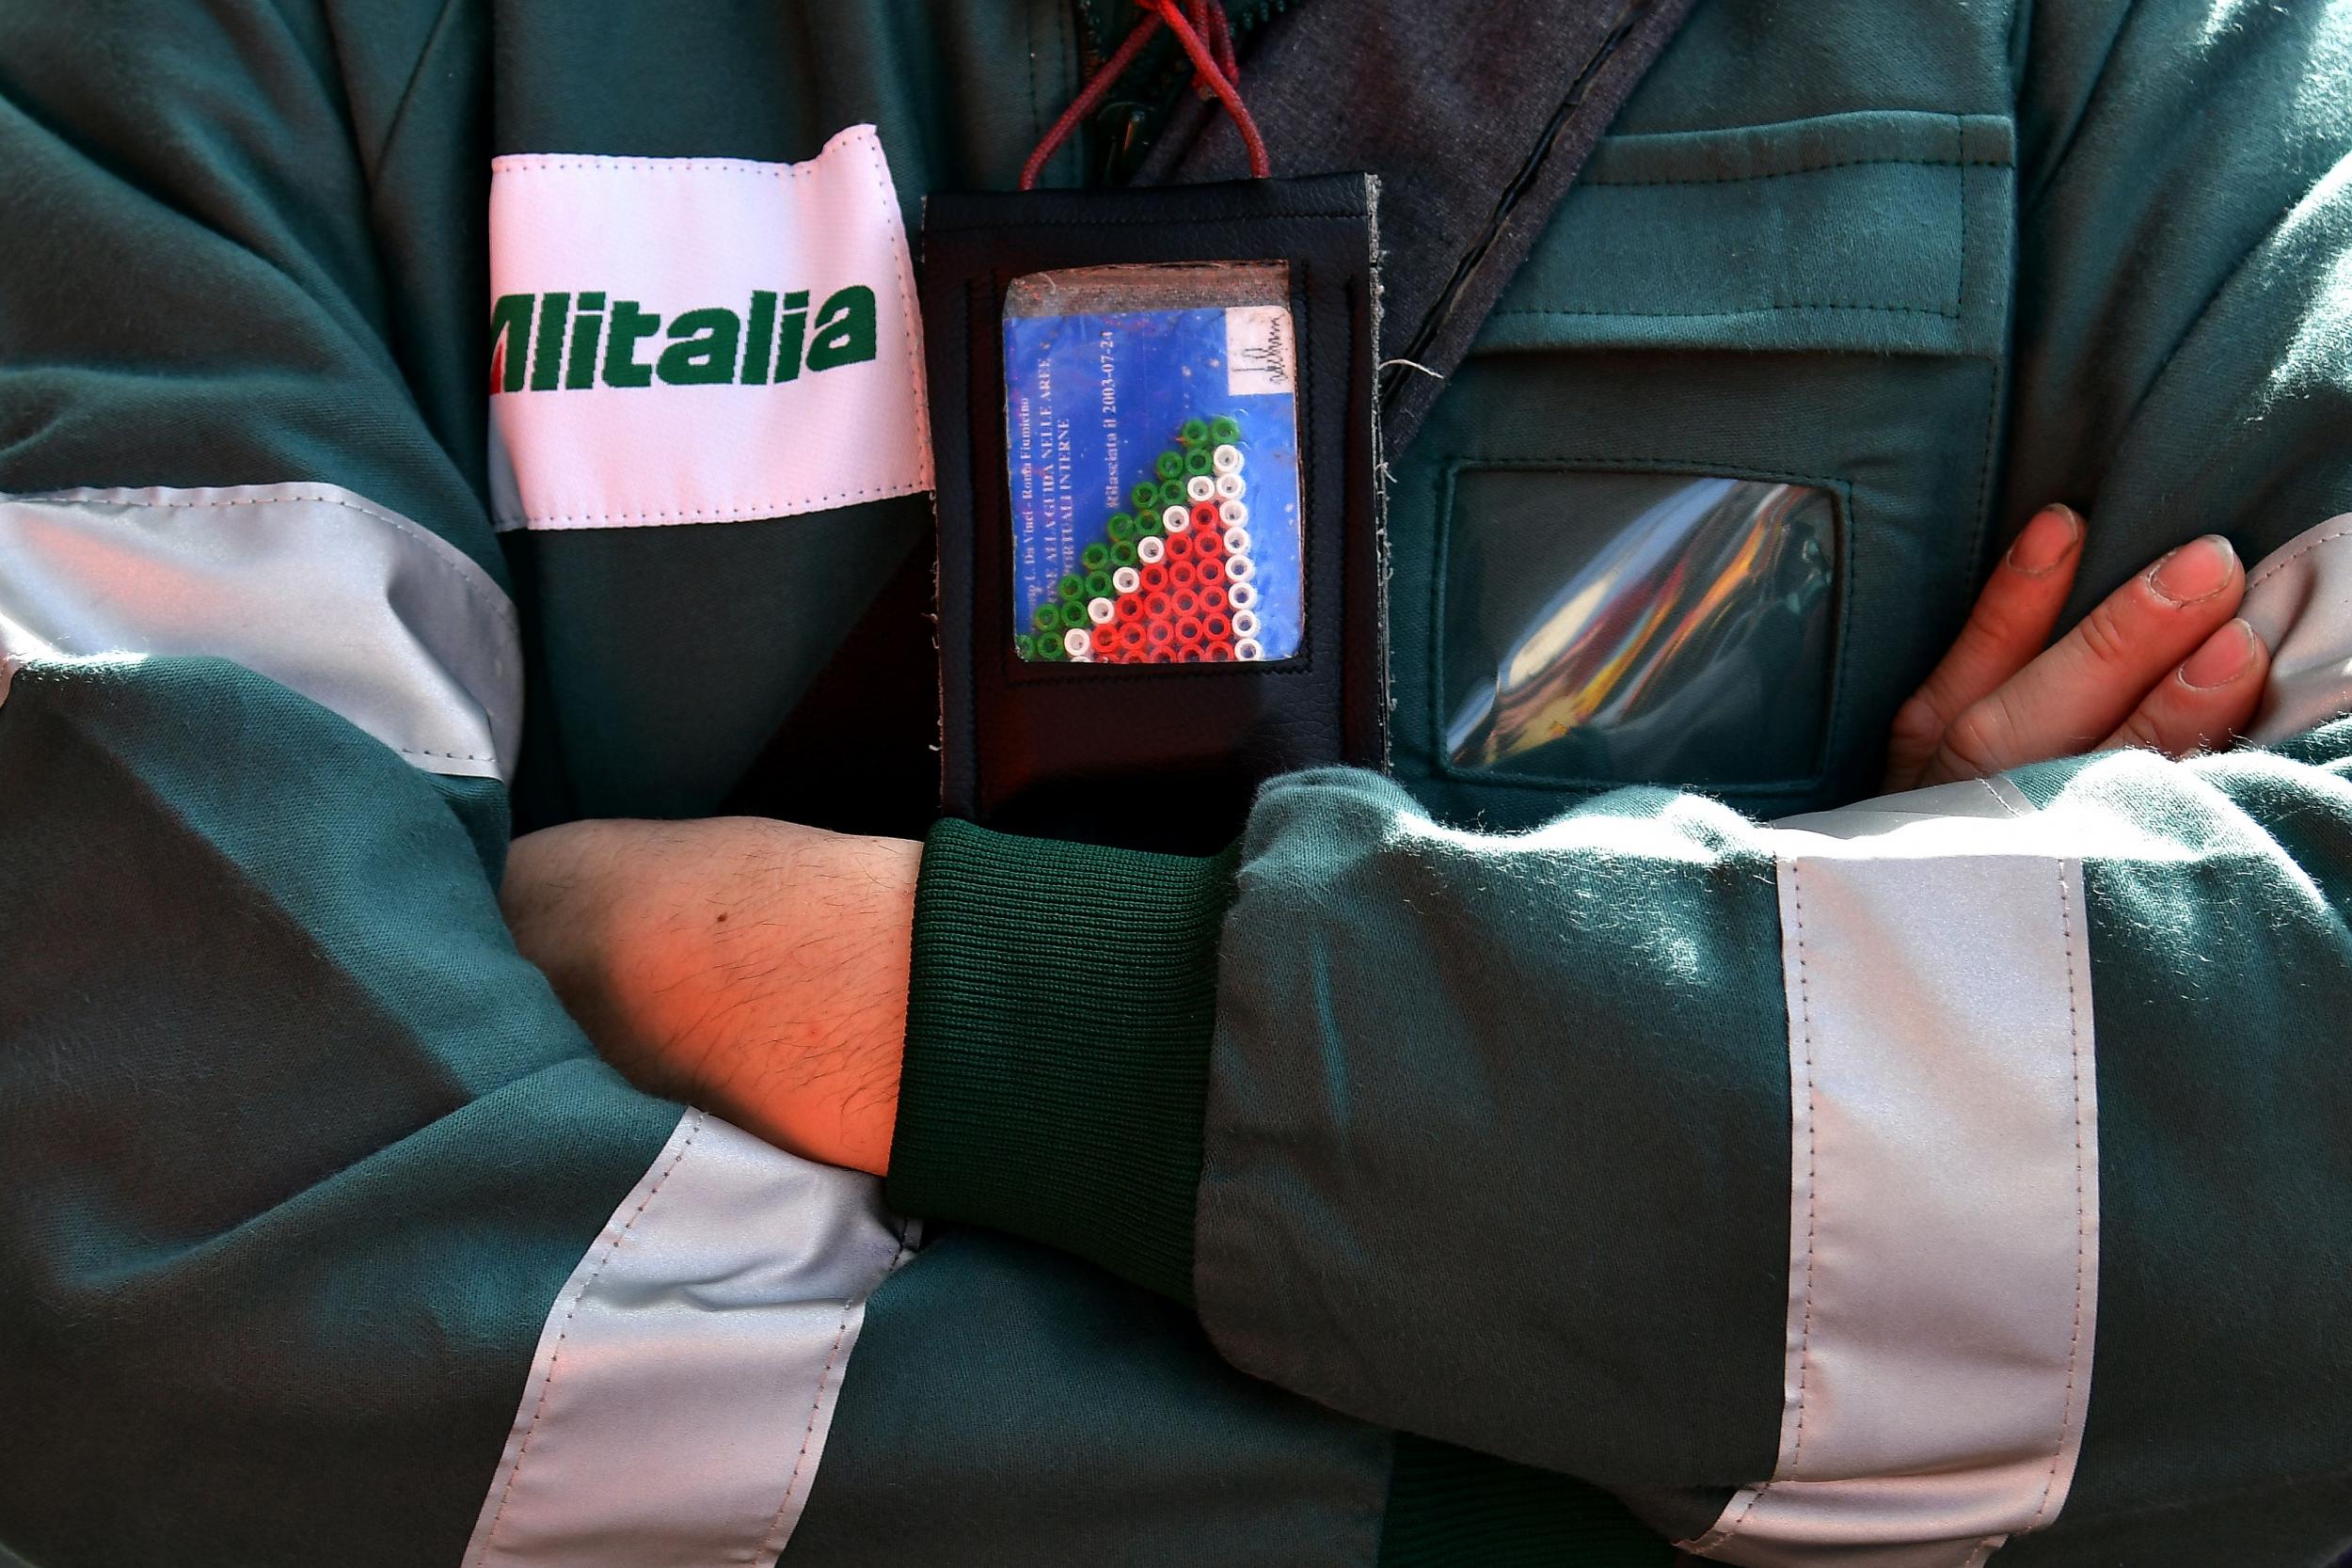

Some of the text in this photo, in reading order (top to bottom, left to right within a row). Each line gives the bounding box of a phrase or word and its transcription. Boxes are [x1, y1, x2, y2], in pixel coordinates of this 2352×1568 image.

[1038, 357, 1053, 401] AREE
[1019, 397, 1032, 459] Fiumicino
[1040, 405, 1054, 459] NELLE
[1100, 331, 1120, 509] Rilasciata il 2003-07-24
[1057, 419, 1072, 490] INTERNE
[1022, 463, 1033, 499] Roma
[1041, 464, 1056, 517] GUIDA
[1021, 511, 1034, 543] Vinci
[1043, 520, 1057, 562] ALLA
[1022, 546, 1035, 564] Da
